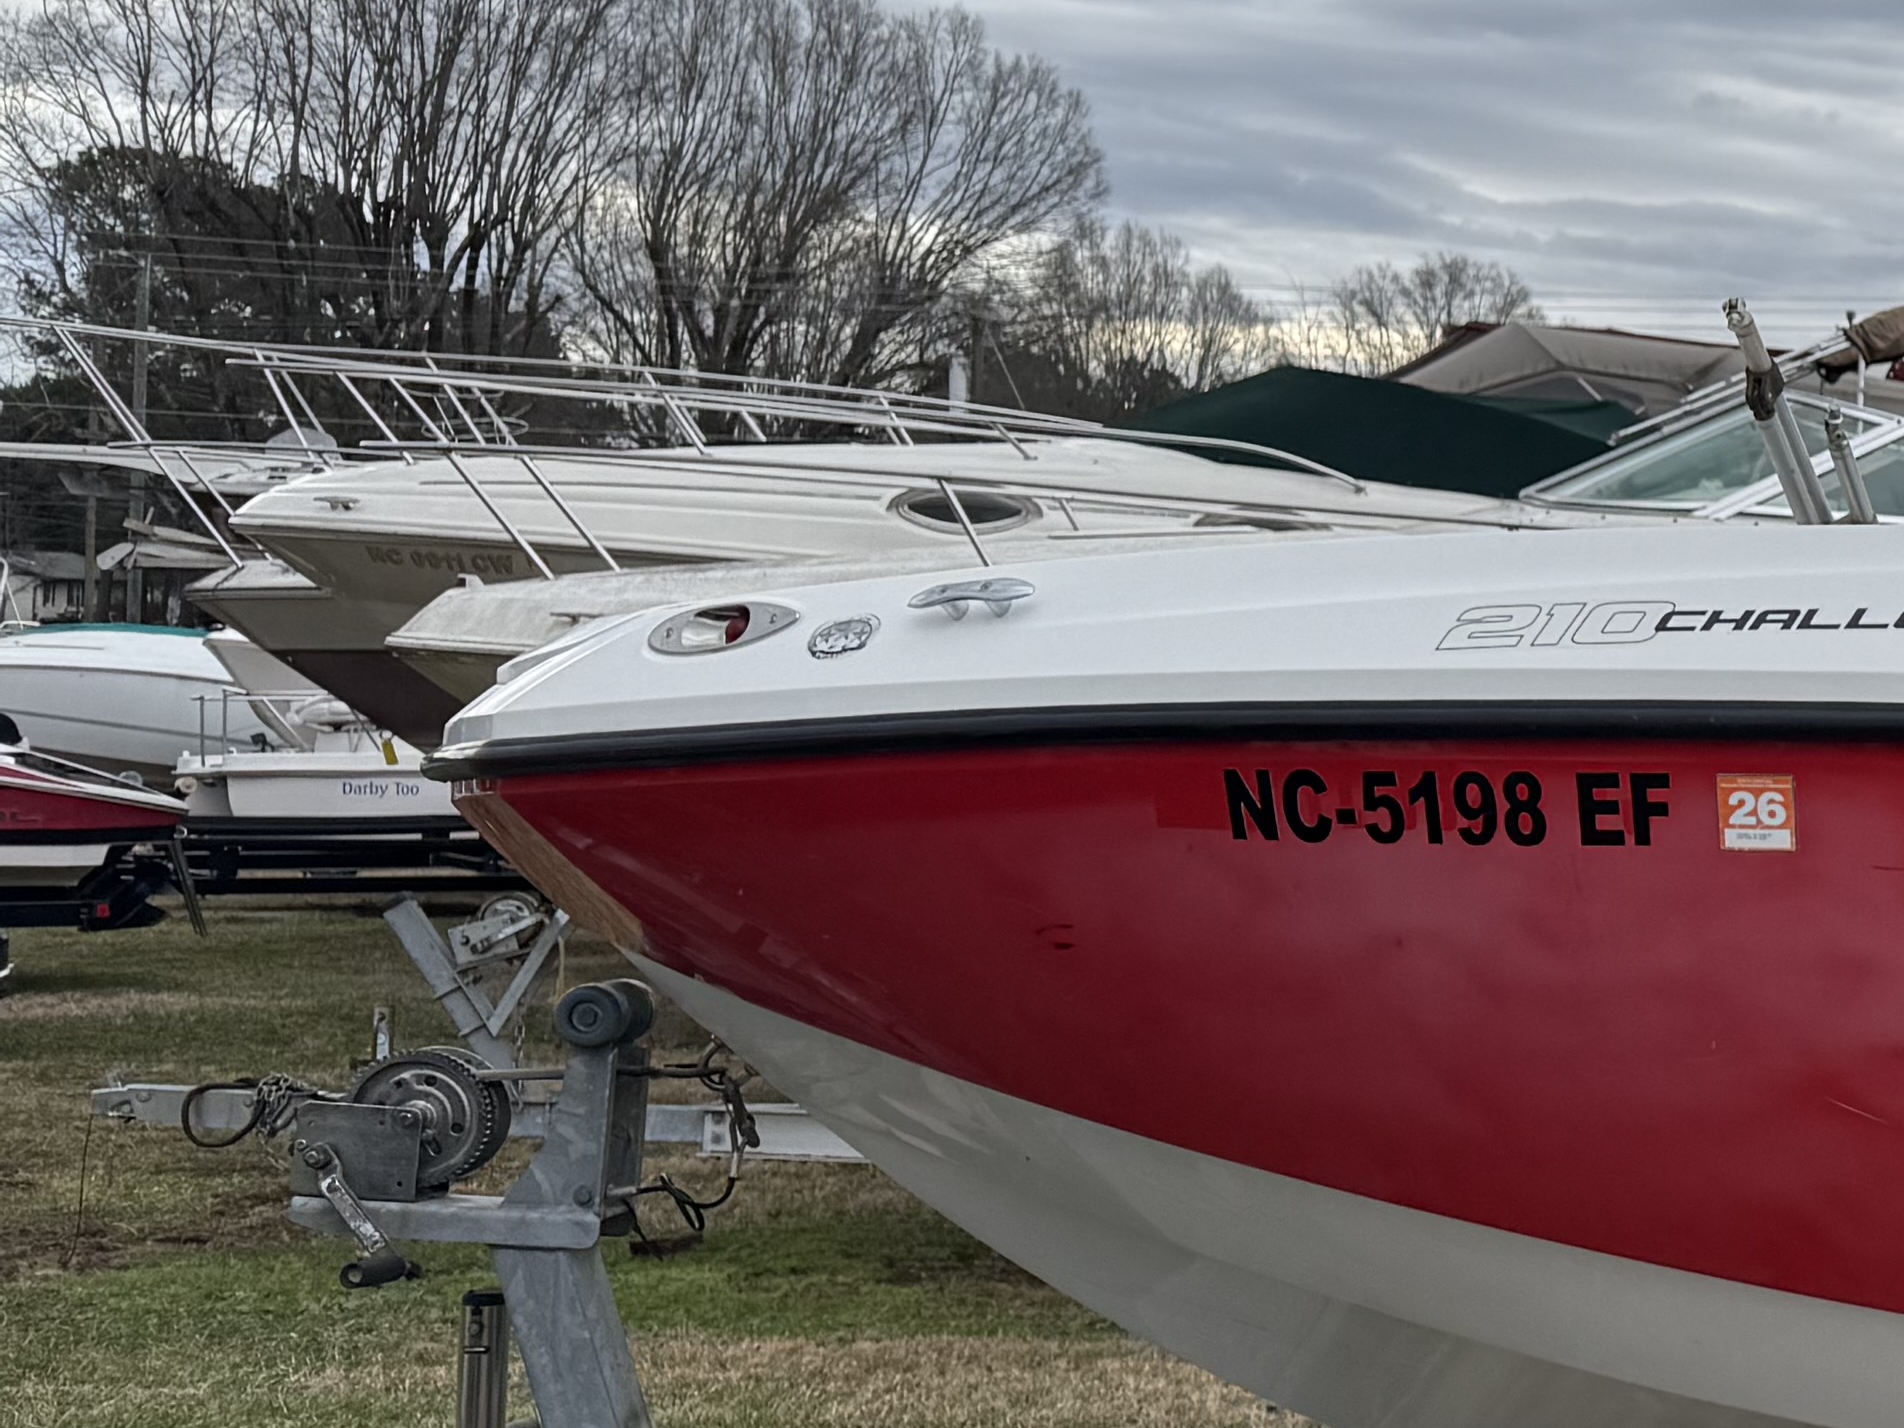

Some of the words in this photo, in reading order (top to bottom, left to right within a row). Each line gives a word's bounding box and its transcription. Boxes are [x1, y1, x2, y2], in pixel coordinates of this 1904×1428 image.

[1435, 600, 1675, 651] 210
[342, 780, 389, 799] Darby
[395, 781, 420, 797] Too
[1223, 767, 1548, 848] NC-5198
[1575, 771, 1671, 847] EF
[1727, 790, 1788, 827] 26
